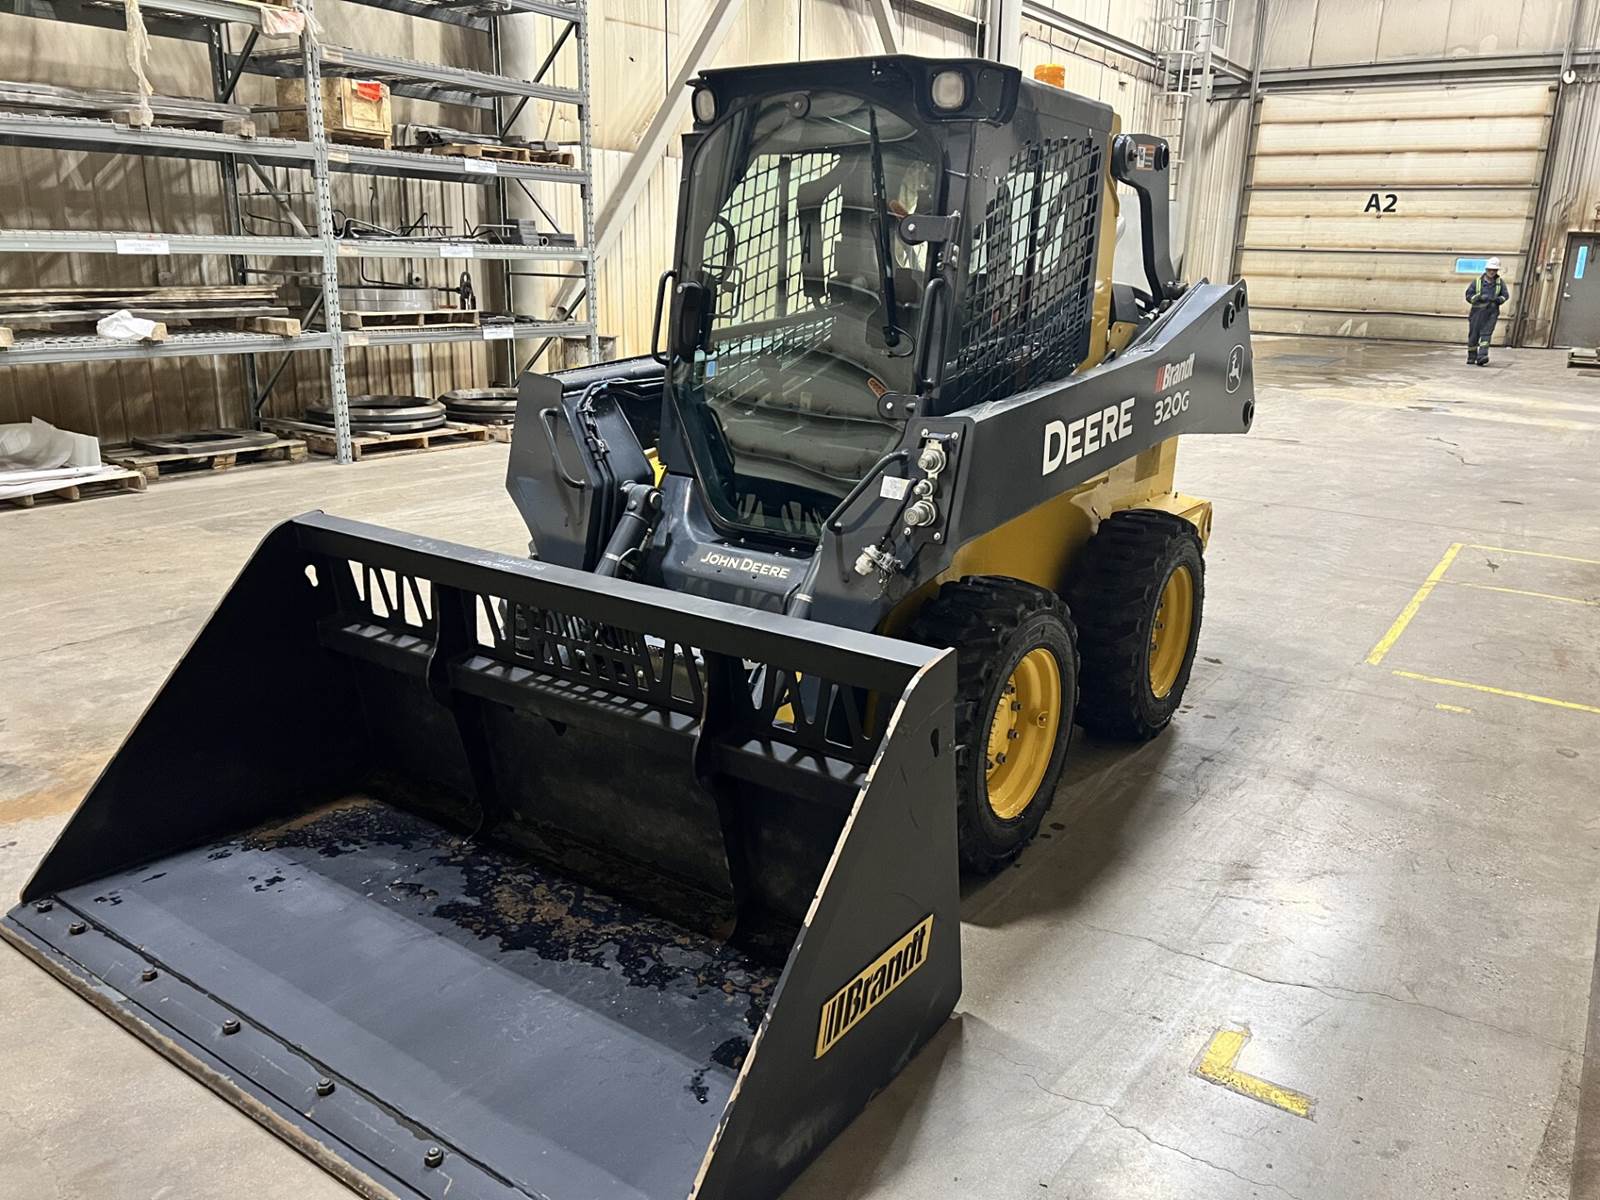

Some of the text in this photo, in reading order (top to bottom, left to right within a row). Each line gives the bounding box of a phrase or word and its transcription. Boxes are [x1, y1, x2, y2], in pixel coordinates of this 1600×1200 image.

[1364, 193, 1398, 213] A2
[1161, 353, 1195, 390] Brandt
[1153, 390, 1190, 426] 320G
[1042, 397, 1136, 476] DEERE
[700, 551, 790, 579] JOHN DEERE
[842, 924, 926, 1030] Brandt
